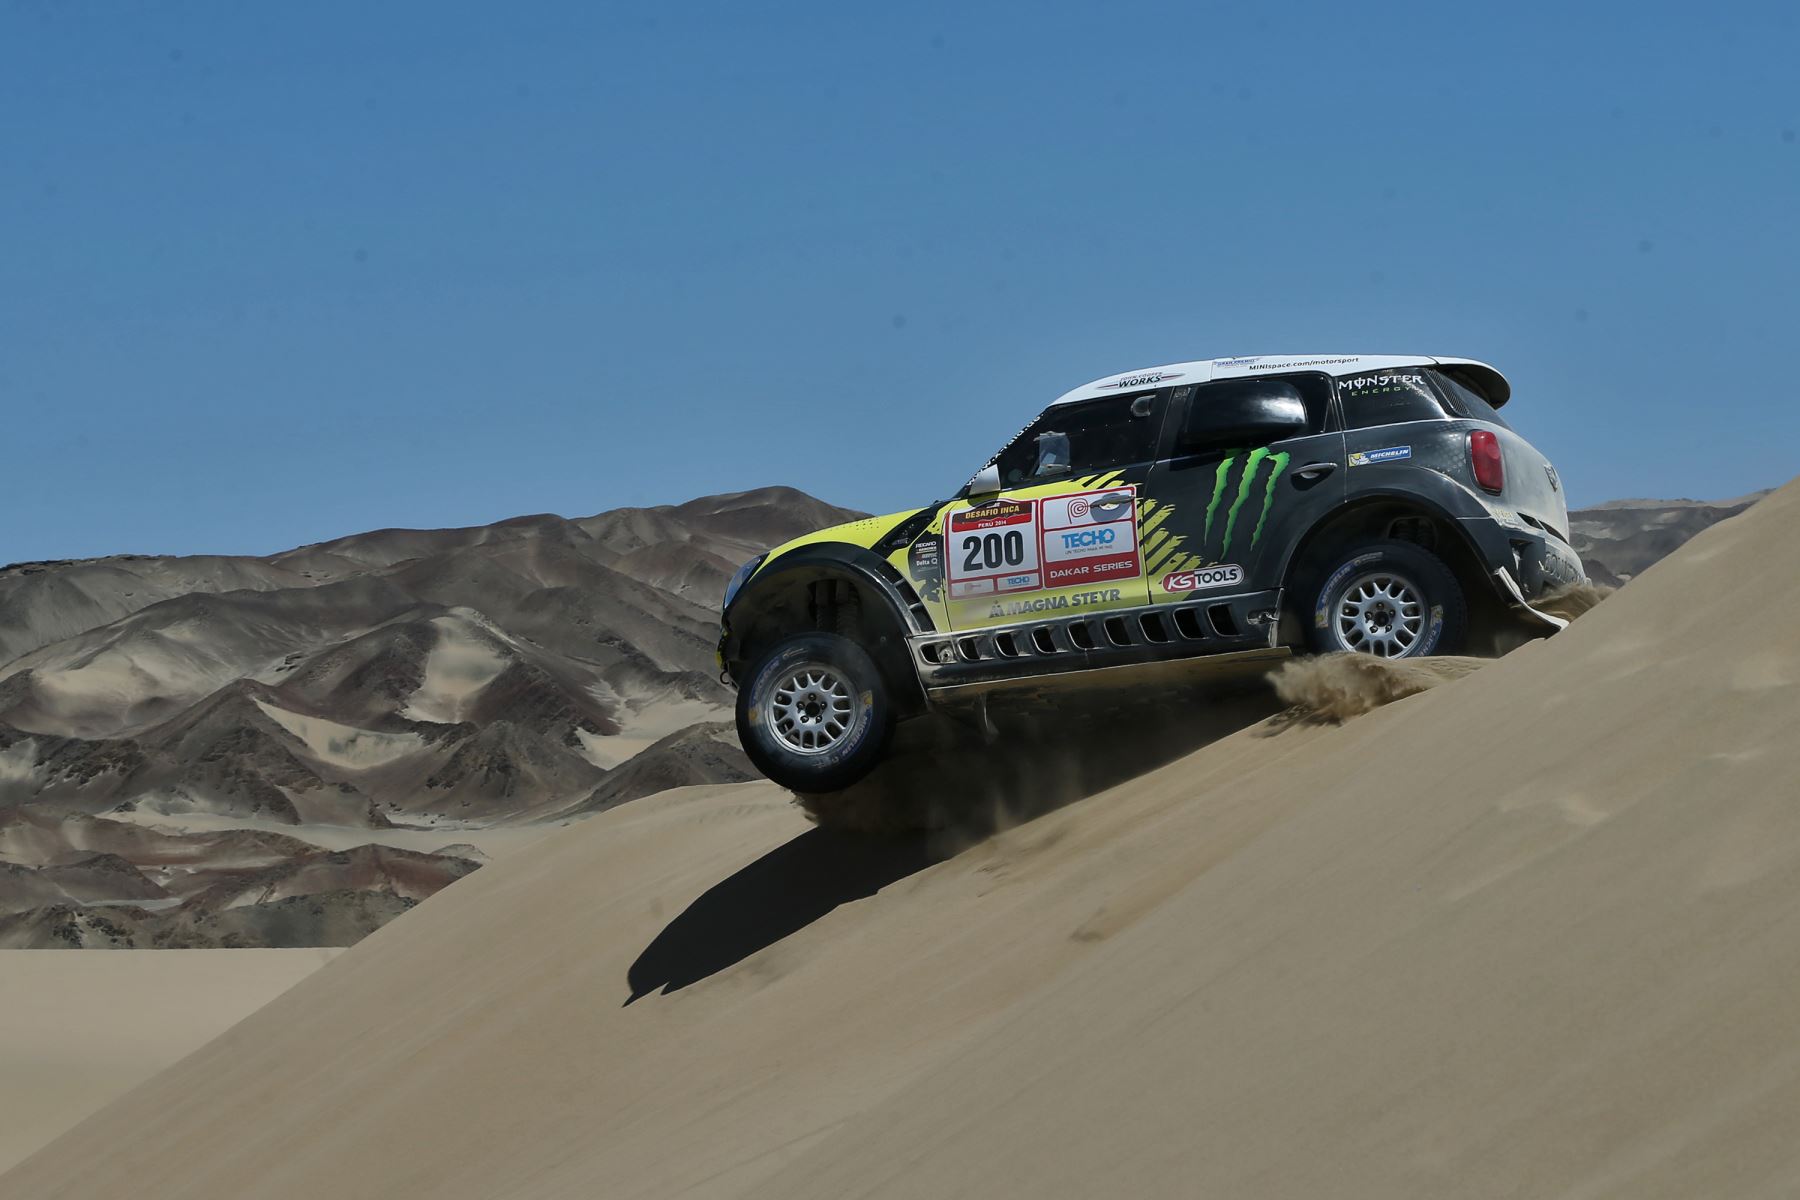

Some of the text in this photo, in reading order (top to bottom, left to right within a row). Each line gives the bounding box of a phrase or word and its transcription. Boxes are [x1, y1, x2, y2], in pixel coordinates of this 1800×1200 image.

[1248, 357, 1359, 371] MINIspace.com/motorsport
[1119, 375, 1161, 388] WORKS
[1351, 386, 1411, 397] ENERGY
[1370, 449, 1409, 459] MICHELIN
[1000, 505, 1020, 515] INCA
[915, 541, 937, 549] RECARO
[1061, 528, 1115, 549] TECHO
[962, 530, 1024, 572] 200
[916, 559, 930, 567] Delta
[1050, 560, 1133, 579] DAKAR SERIES
[1007, 576, 1030, 585] TECHO
[1194, 569, 1238, 585] TOOLS
[1007, 589, 1121, 616] MAGNA STEYR
